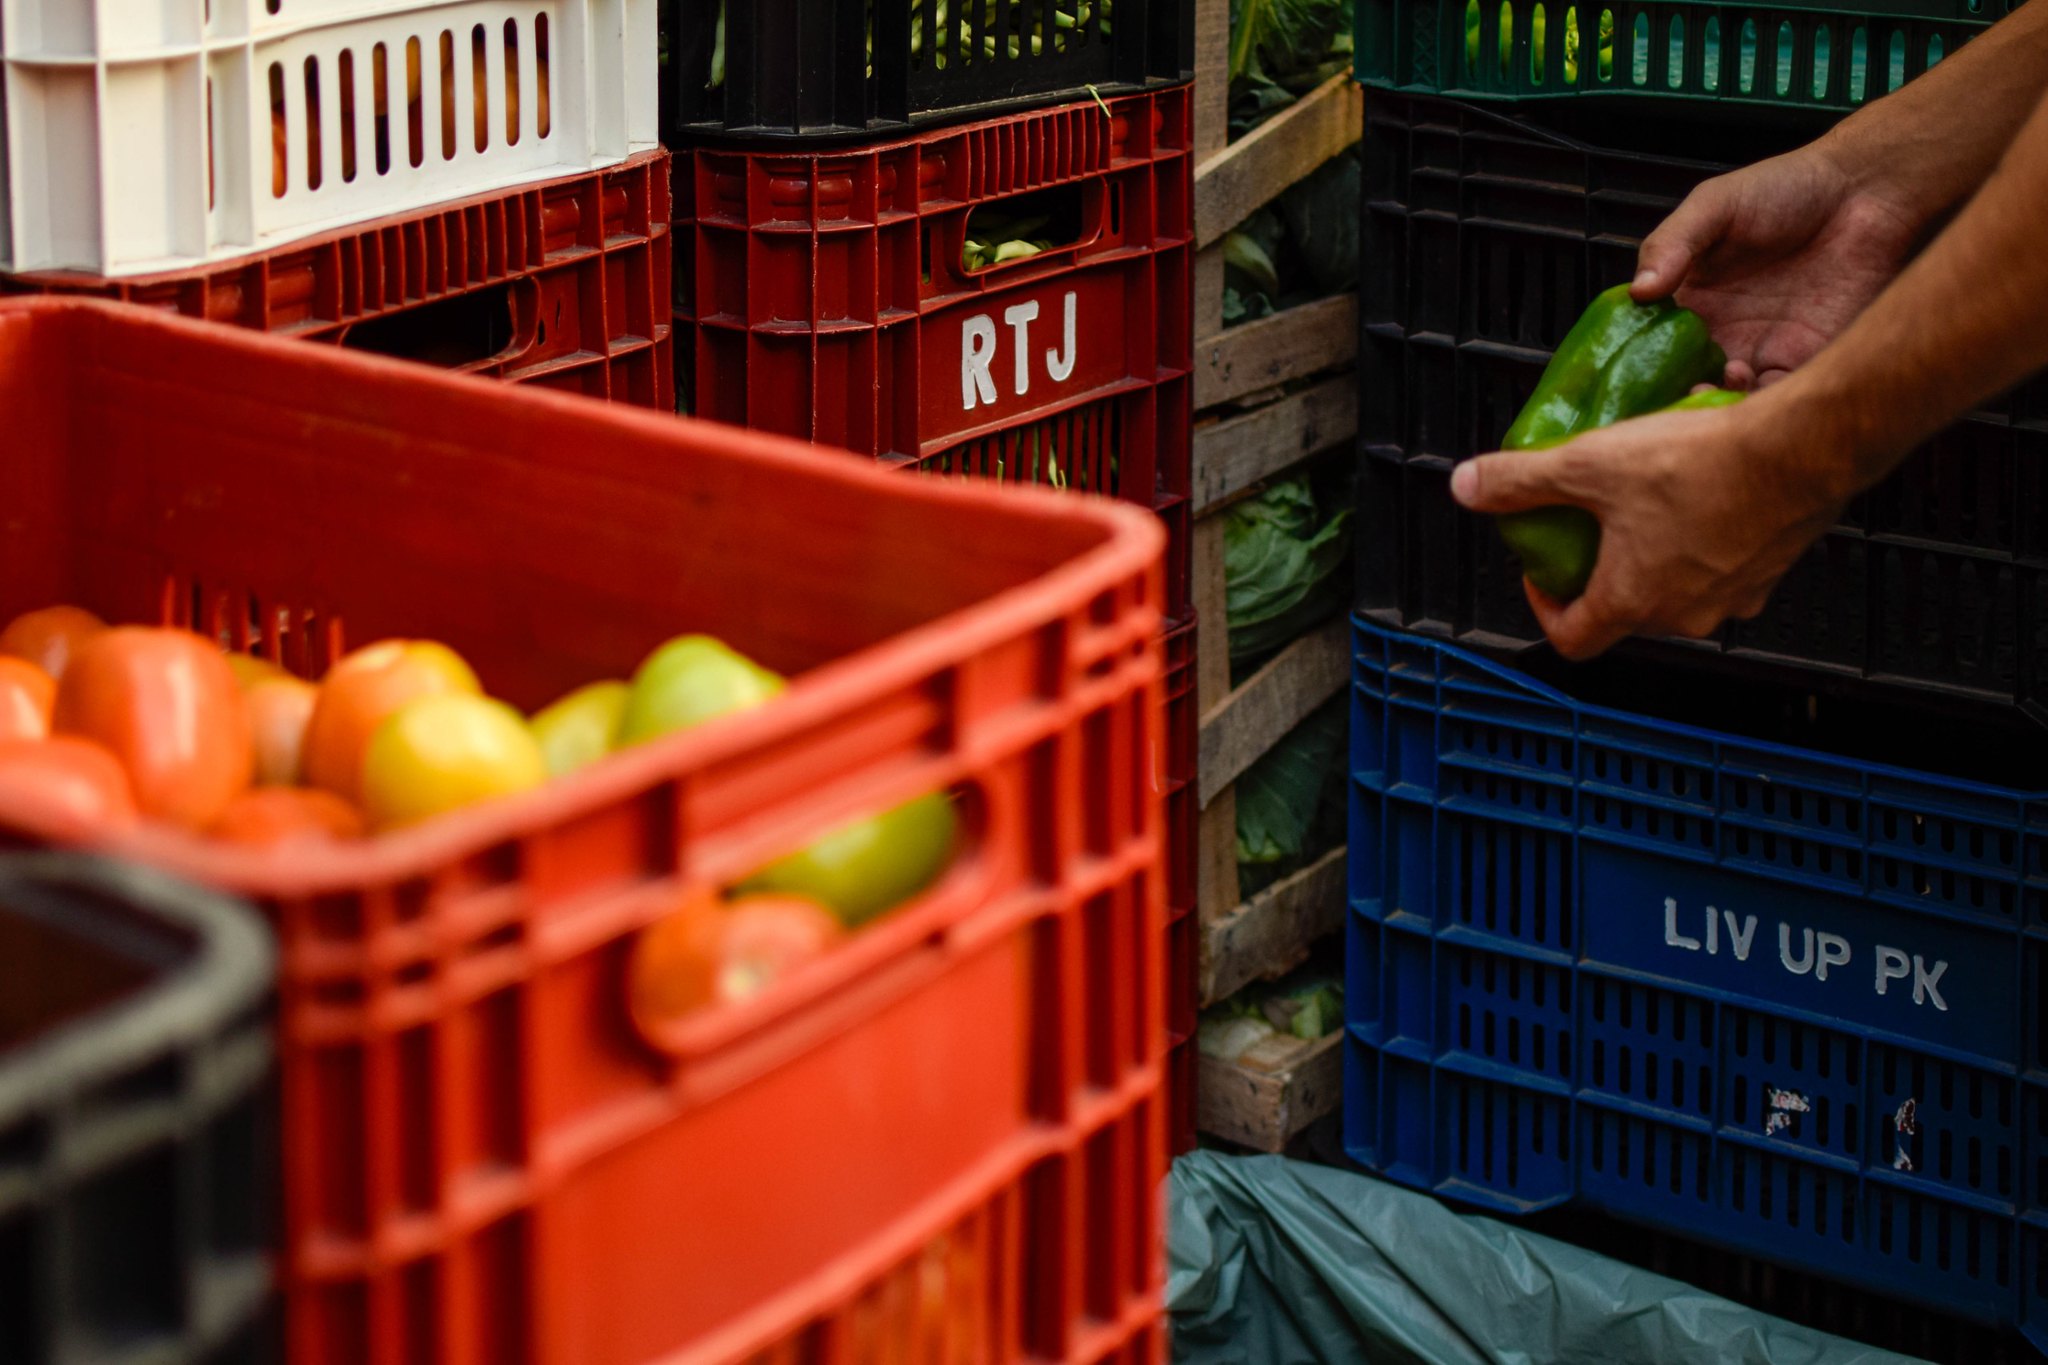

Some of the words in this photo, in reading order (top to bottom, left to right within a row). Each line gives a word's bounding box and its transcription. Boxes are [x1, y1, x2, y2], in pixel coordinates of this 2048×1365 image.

[962, 290, 1077, 410] RTJ
[1664, 896, 1758, 960] LIV
[1778, 922, 1851, 981] UP
[1875, 944, 1948, 1011] PK
